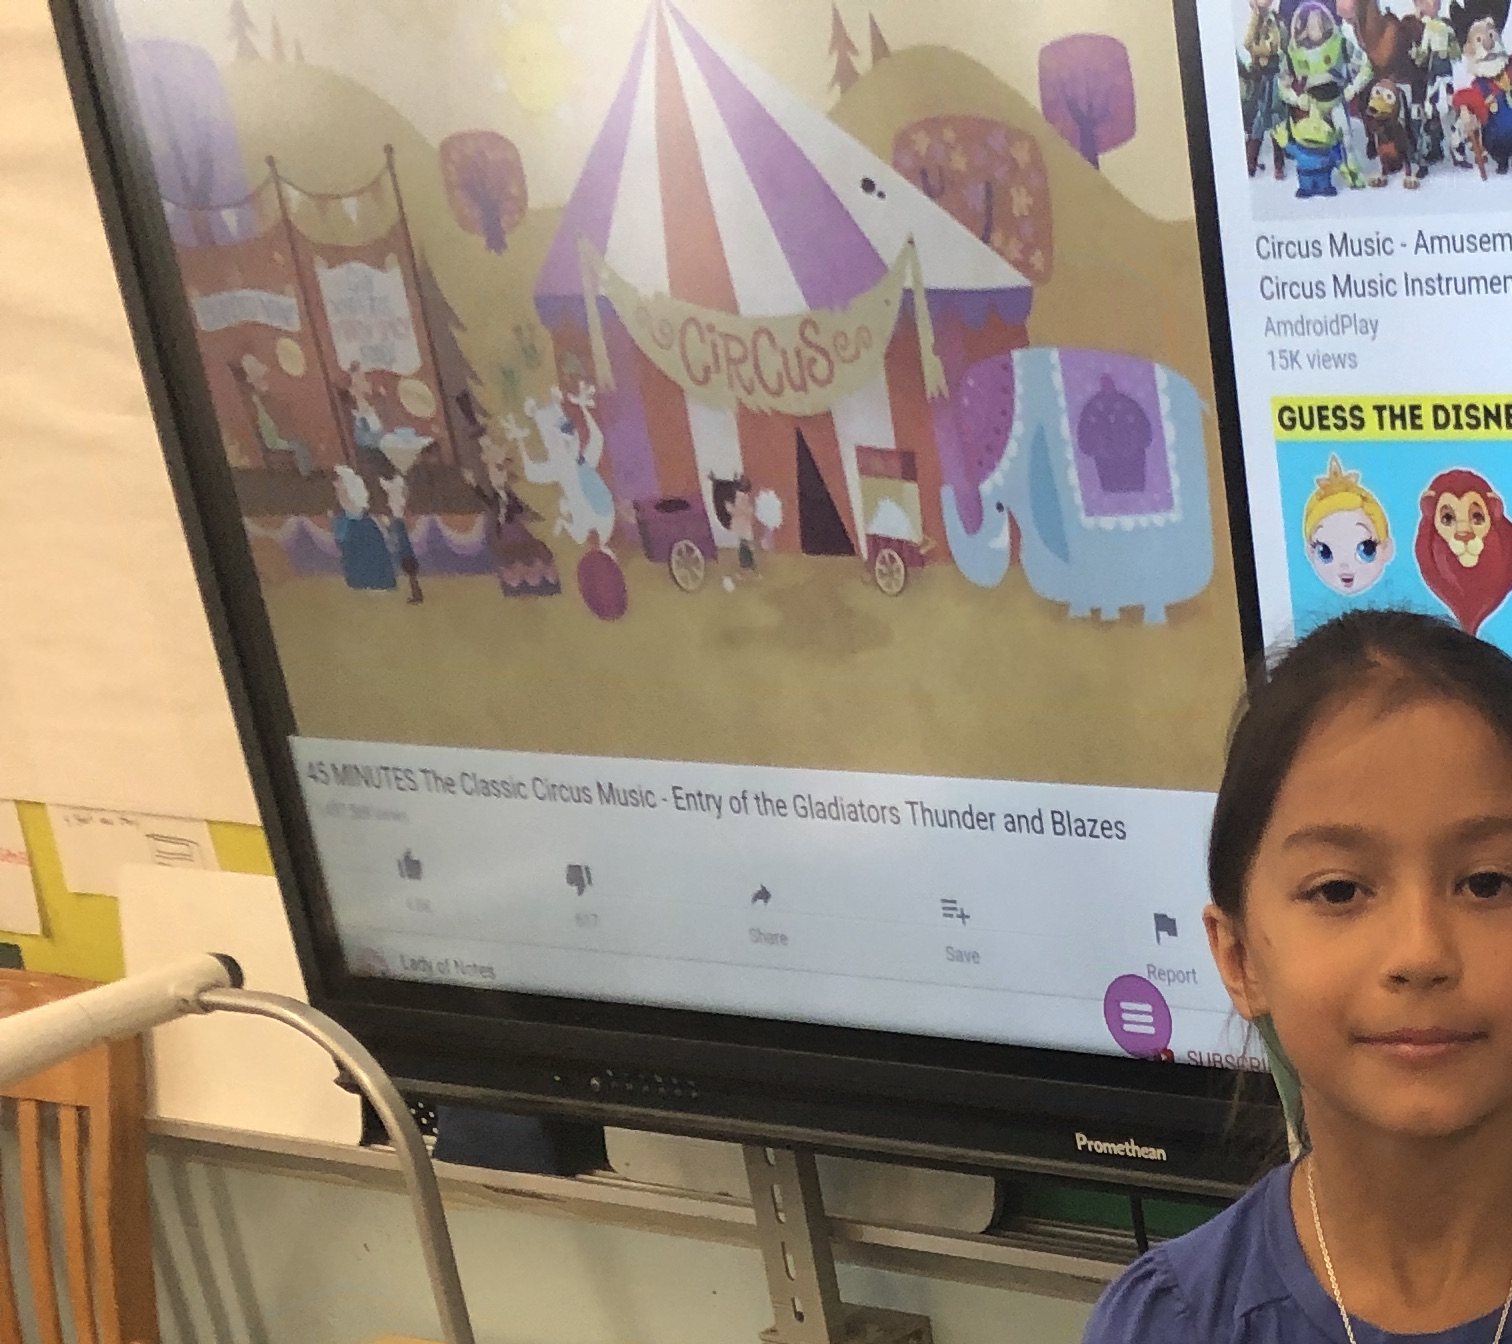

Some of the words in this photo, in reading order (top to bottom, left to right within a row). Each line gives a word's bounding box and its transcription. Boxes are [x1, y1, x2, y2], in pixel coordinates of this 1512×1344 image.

[1255, 234, 1323, 260] Circus
[1329, 231, 1395, 258] Music
[1259, 274, 1327, 301] Circus
[1332, 273, 1398, 299] Music
[1264, 312, 1380, 342] AmdroidPlay
[1267, 348, 1303, 371] 15K
[1306, 349, 1359, 371] views
[1277, 403, 1366, 432] GUESS
[1371, 402, 1425, 431] THE
[307, 761, 330, 786] 45
[331, 764, 418, 793] MINUTES
[420, 768, 456, 796] The
[459, 773, 527, 801] Classic
[532, 776, 594, 805] Circus
[598, 780, 657, 810] Music
[671, 785, 723, 820] Entry
[728, 790, 751, 816] of
[754, 791, 788, 818] the
[792, 793, 901, 826] Gladiators
[904, 799, 996, 832] Thunder
[1003, 808, 1045, 837] and
[1051, 810, 1128, 841] Blazes
[748, 927, 789, 947] Share
[944, 946, 981, 966] Save
[1146, 964, 1199, 986] Report
[1074, 1131, 1168, 1162] Promethean
